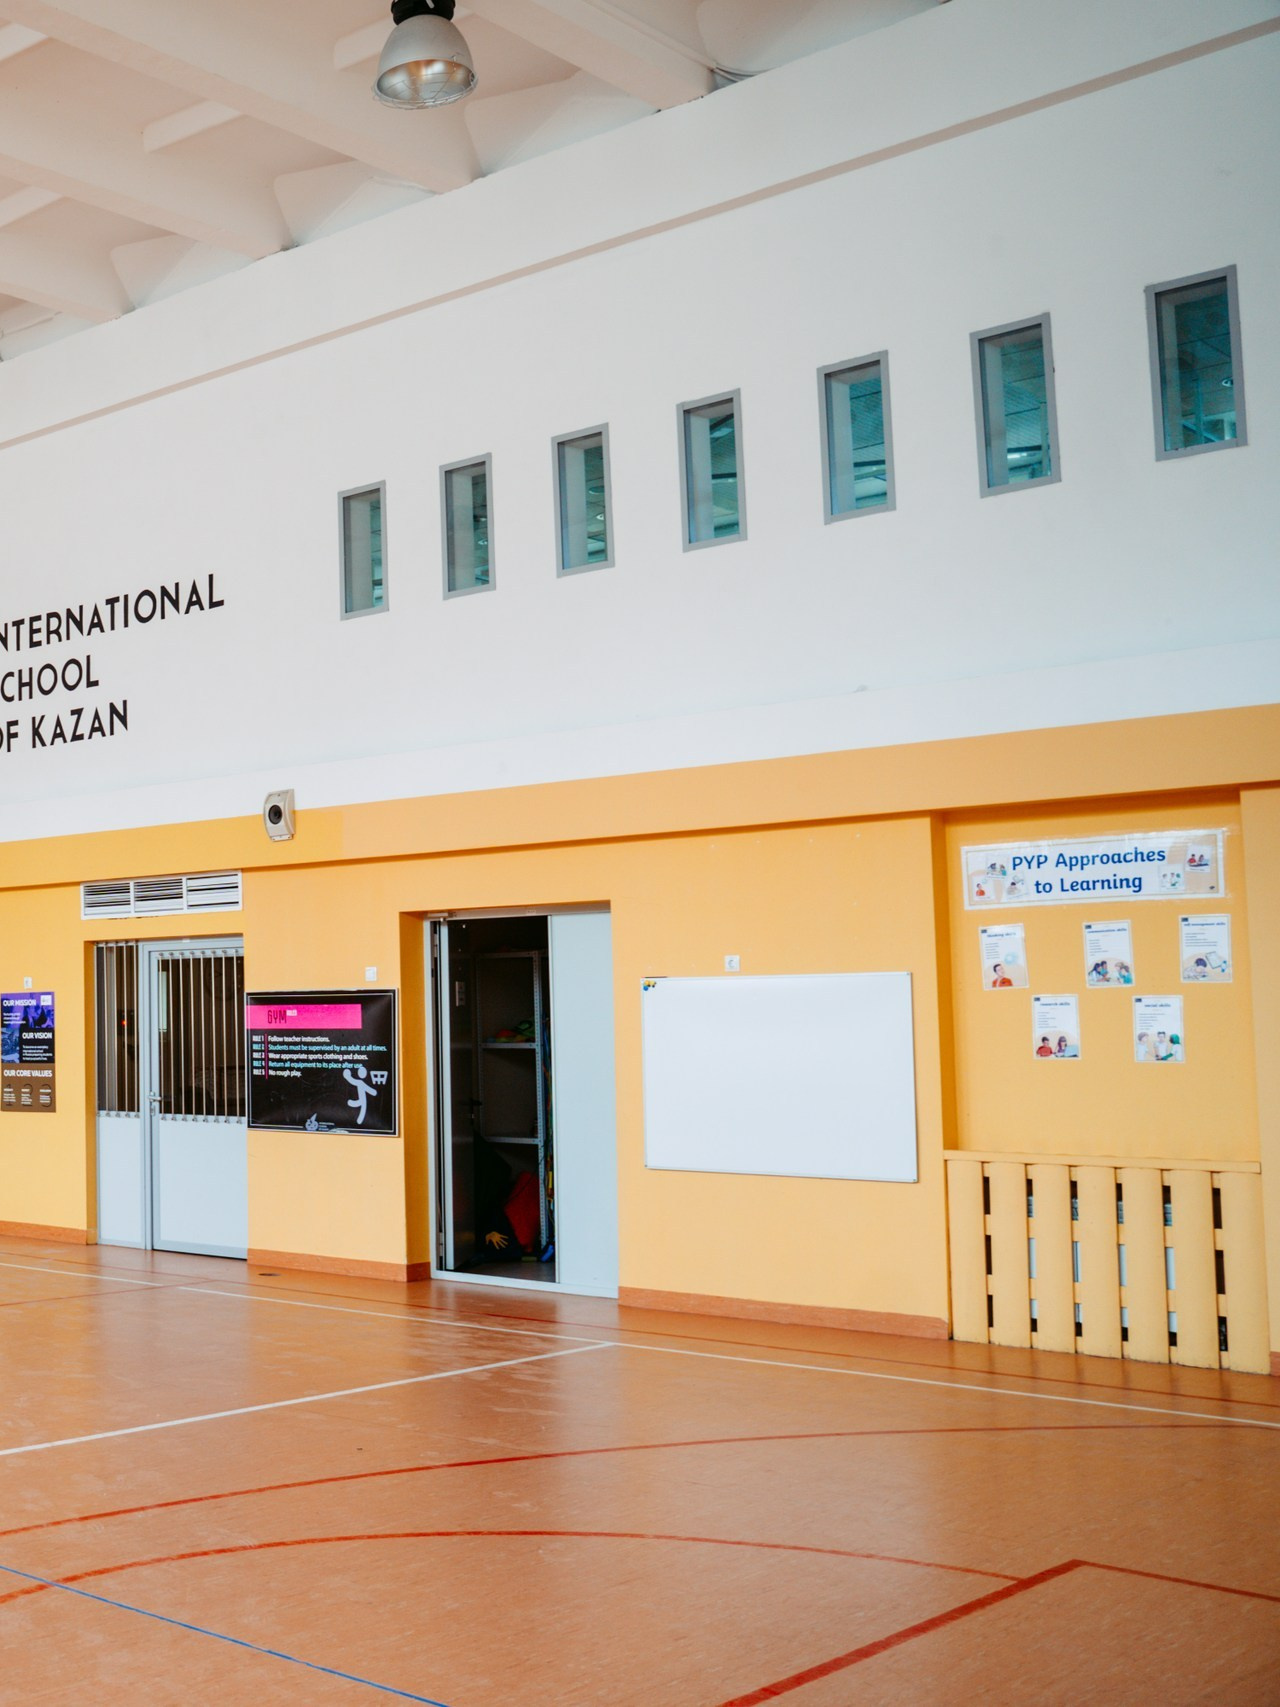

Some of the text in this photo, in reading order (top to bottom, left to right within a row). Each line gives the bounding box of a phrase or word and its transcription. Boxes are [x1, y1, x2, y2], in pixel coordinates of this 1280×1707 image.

[31, 699, 129, 749] KAZAN
[1012, 846, 1166, 872] PYP Approaches
[1034, 873, 1143, 894] to Learning
[268, 1010, 287, 1024] GYM
